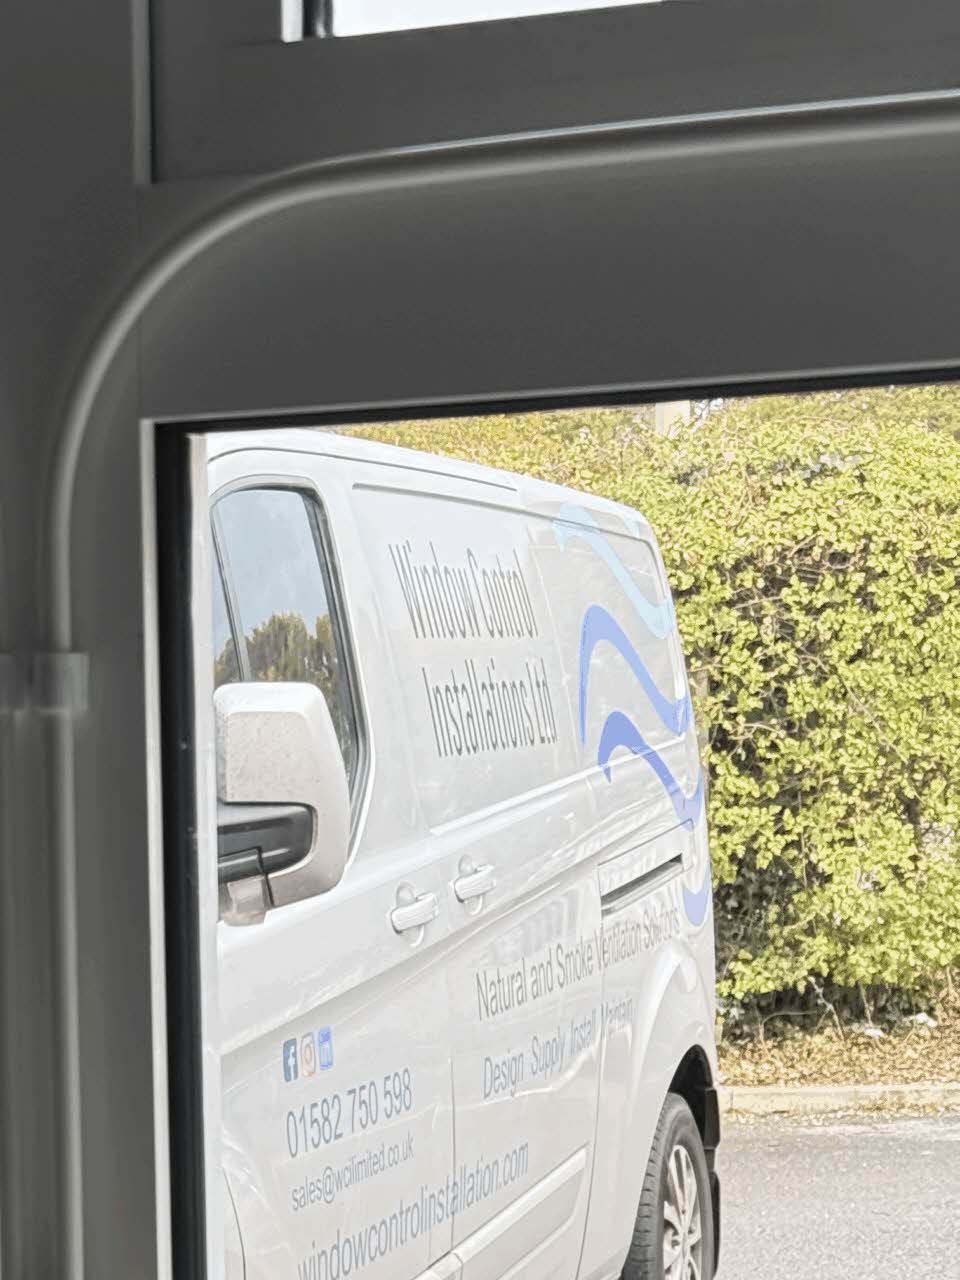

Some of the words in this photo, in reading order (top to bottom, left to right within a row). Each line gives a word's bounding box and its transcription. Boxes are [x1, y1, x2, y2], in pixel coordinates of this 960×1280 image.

[388, 540, 481, 639] Window
[466, 547, 538, 639] Control
[422, 657, 536, 757] Installations
[527, 657, 558, 744] Ltd
[477, 958, 528, 1021] Natural
[531, 946, 554, 1000] and
[557, 940, 593, 989] Smoke
[595, 921, 641, 971] Ventilation
[483, 1049, 524, 1099] Design
[531, 1028, 566, 1079] Supply
[570, 1008, 596, 1057] Install
[286, 1095, 343, 1158] 01582
[347, 1081, 380, 1134] 750
[383, 1069, 413, 1118] 598
[291, 1131, 414, 1212] sales@wcilimited.co.uk
